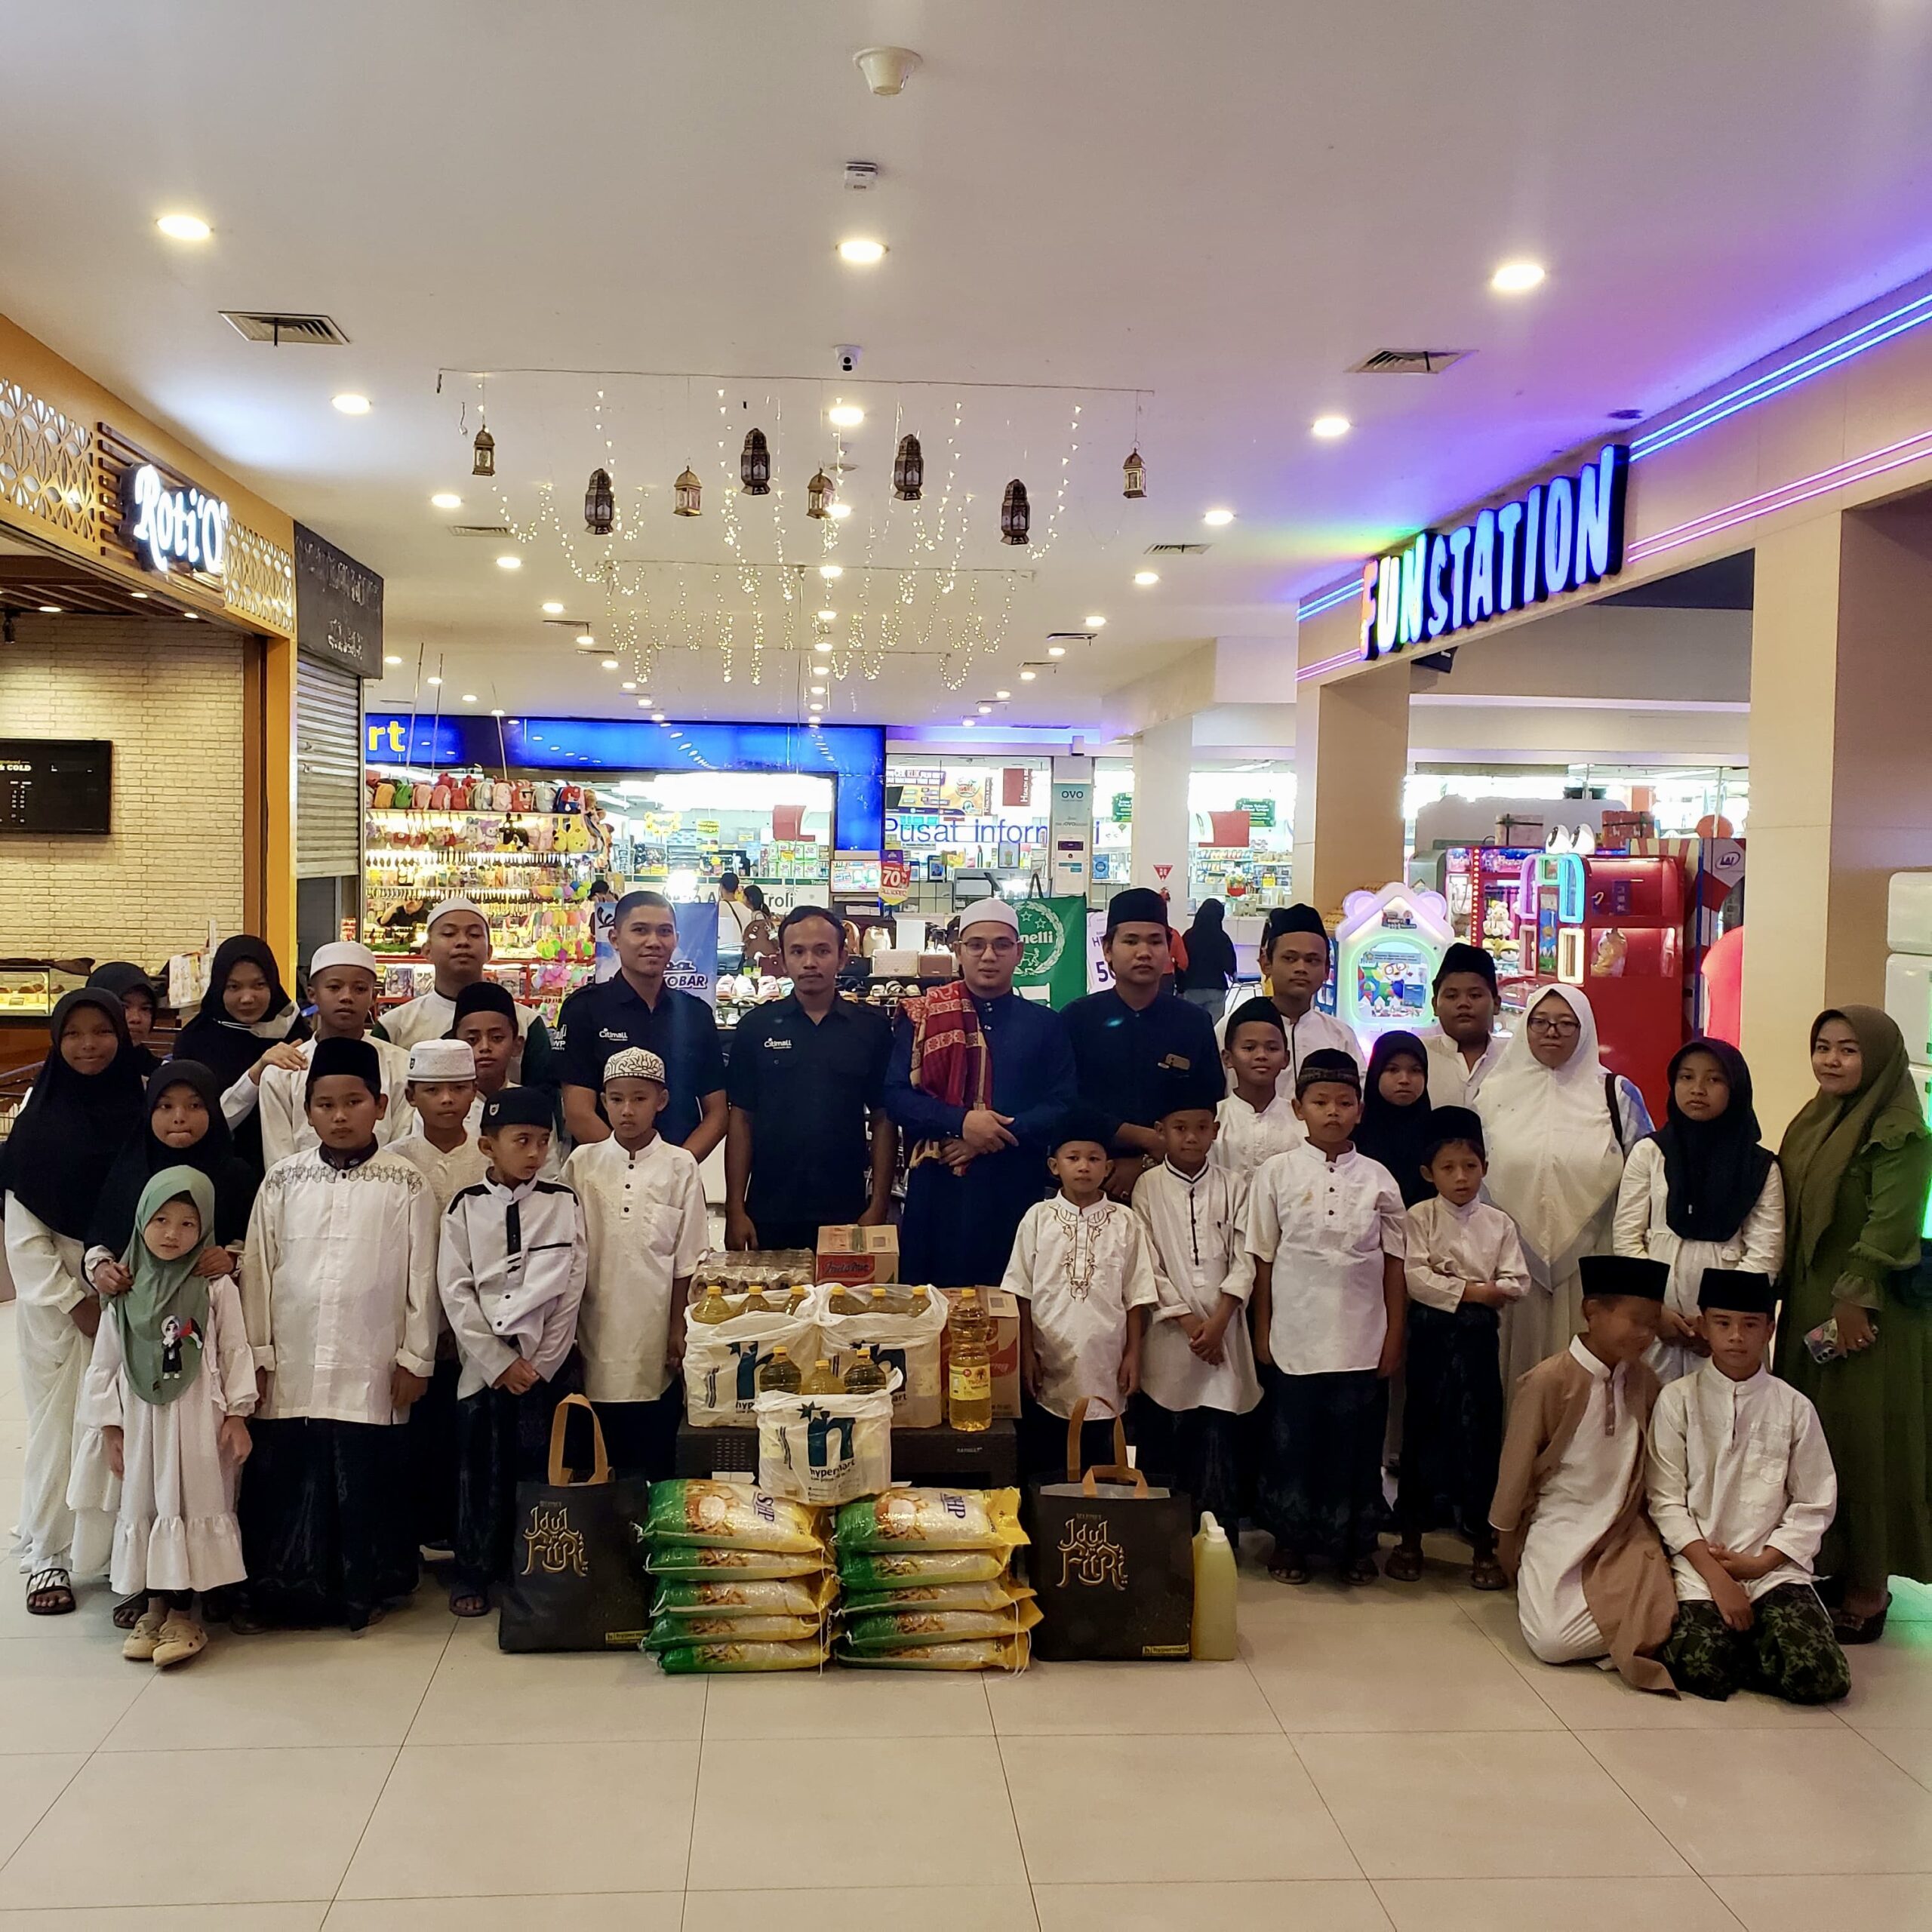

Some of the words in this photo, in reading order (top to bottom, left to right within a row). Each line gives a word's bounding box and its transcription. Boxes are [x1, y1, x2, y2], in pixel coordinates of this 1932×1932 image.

[1061, 790, 1084, 799] OVO
[885, 818, 958, 843] Pusat
[1020, 931, 1054, 944] nelli
